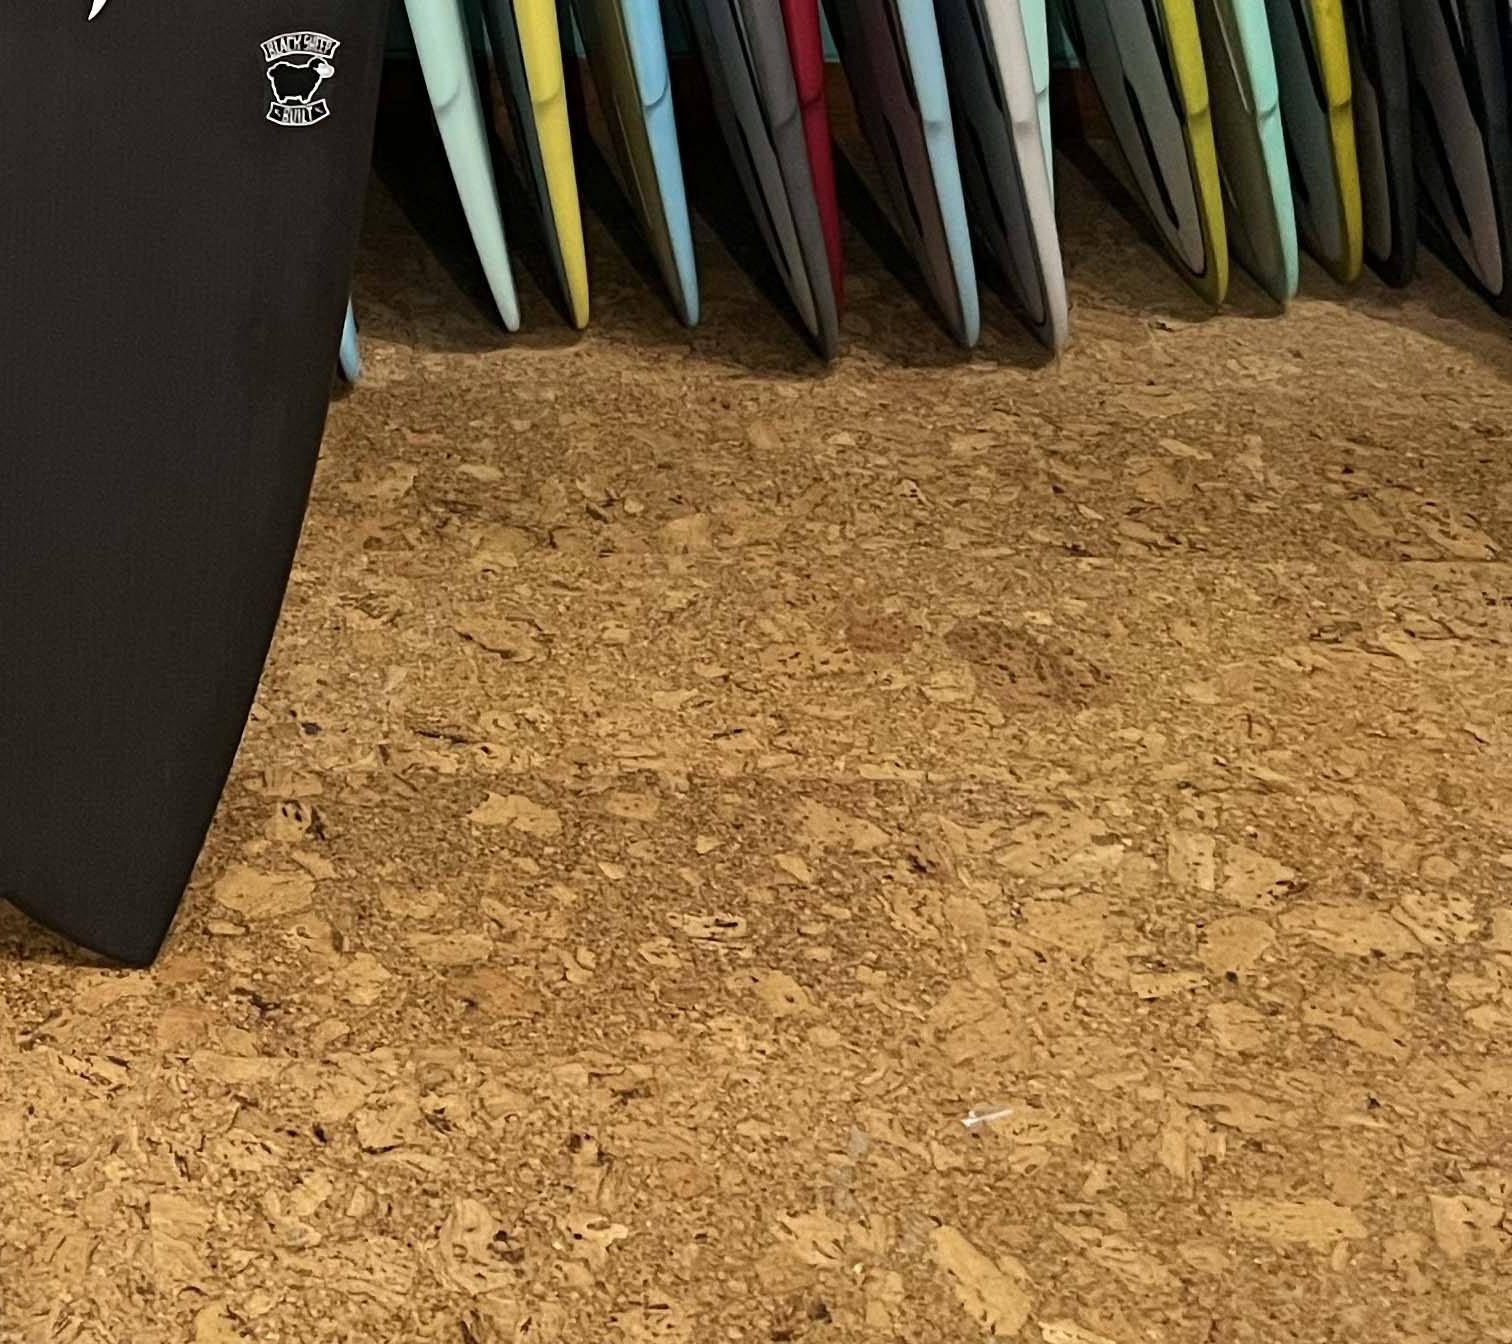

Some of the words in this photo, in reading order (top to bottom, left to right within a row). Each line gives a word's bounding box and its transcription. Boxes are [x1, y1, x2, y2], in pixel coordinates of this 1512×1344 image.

[267, 35, 302, 57] BLACK
[303, 35, 333, 54] SHEEP
[282, 107, 313, 124] BUILT
